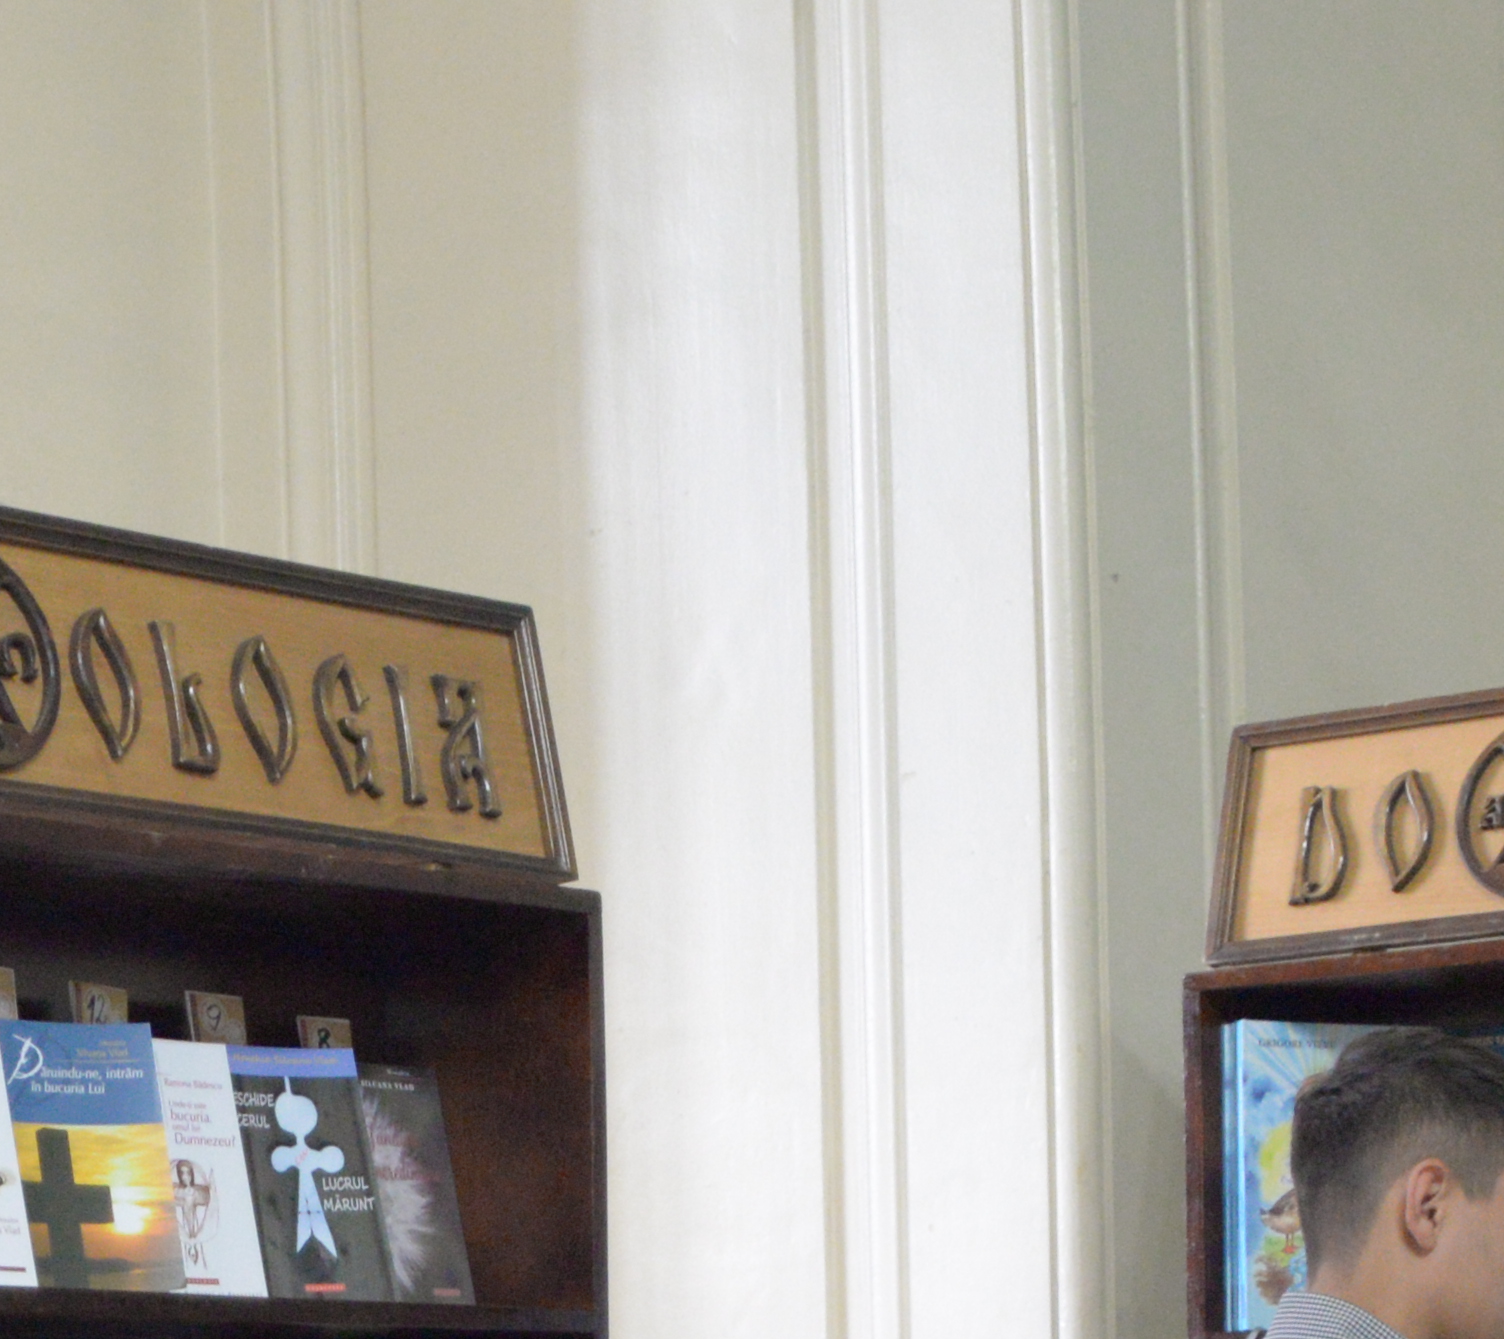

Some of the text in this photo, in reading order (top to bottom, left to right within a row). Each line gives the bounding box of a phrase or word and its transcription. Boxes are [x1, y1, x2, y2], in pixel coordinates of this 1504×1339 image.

[44, 1081, 85, 1095] bucuria
[88, 1083, 106, 1095] Lui
[321, 1176, 370, 1191] LUCRUL
